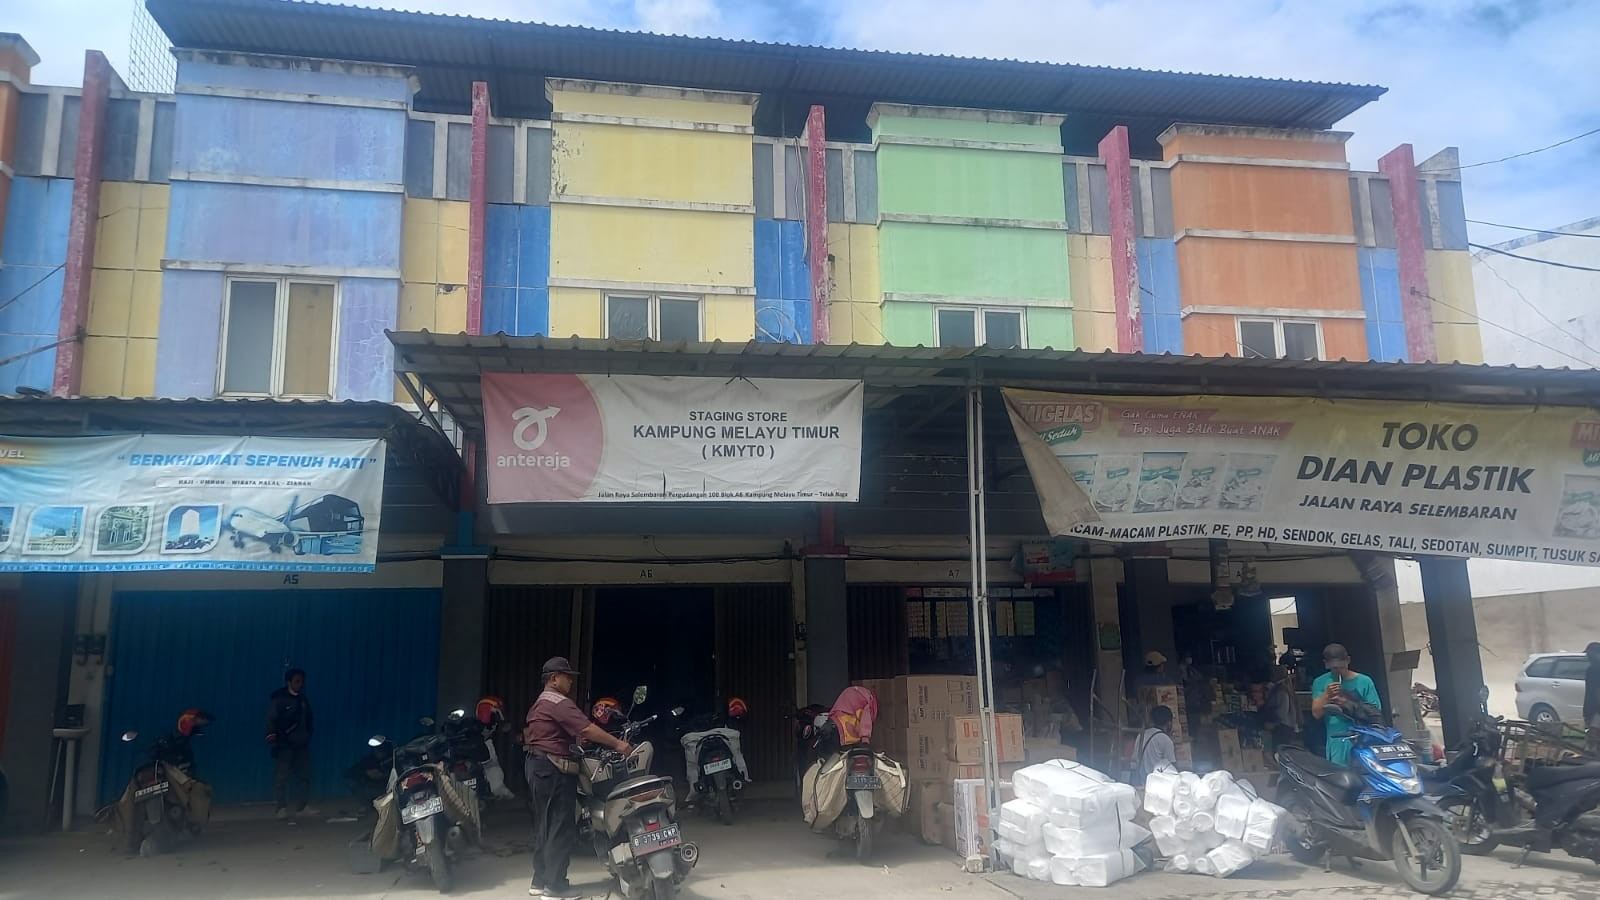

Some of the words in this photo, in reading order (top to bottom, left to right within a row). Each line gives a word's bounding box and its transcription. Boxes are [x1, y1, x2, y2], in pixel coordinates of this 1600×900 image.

[689, 411, 744, 422] STAGING
[747, 412, 788, 422] STORE
[633, 425, 716, 439] KAMPUNG
[721, 426, 788, 440] MELAYU
[792, 427, 840, 440] TIMUR
[1156, 424, 1182, 437] Juga
[1218, 425, 1245, 436] Buat
[1250, 427, 1281, 437] ANAK
[1382, 422, 1479, 451] TOKO
[129, 453, 241, 467] BERKHIDMAT
[244, 454, 324, 469] SEPENUH
[328, 457, 367, 471] HATI
[497, 451, 571, 471] anteraja
[1296, 455, 1394, 486] DIAN
[1401, 463, 1535, 494] PLASTIK
[1299, 494, 1355, 510] JALAN
[1359, 498, 1403, 514] RAYA
[1408, 502, 1517, 521] SELEMBARAN
[1158, 524, 1208, 538] PLASTIK,
[1212, 524, 1231, 538] PE,
[1257, 527, 1278, 541] HD,
[1282, 528, 1336, 546] SENDOK,
[1341, 533, 1383, 548] GELAS,
[1388, 536, 1417, 551] TALI,
[1421, 538, 1482, 556] SEDOTAN,
[1486, 543, 1538, 560] SUMPIT,
[1543, 547, 1585, 563] TUSUK
[283, 574, 299, 584] A5
